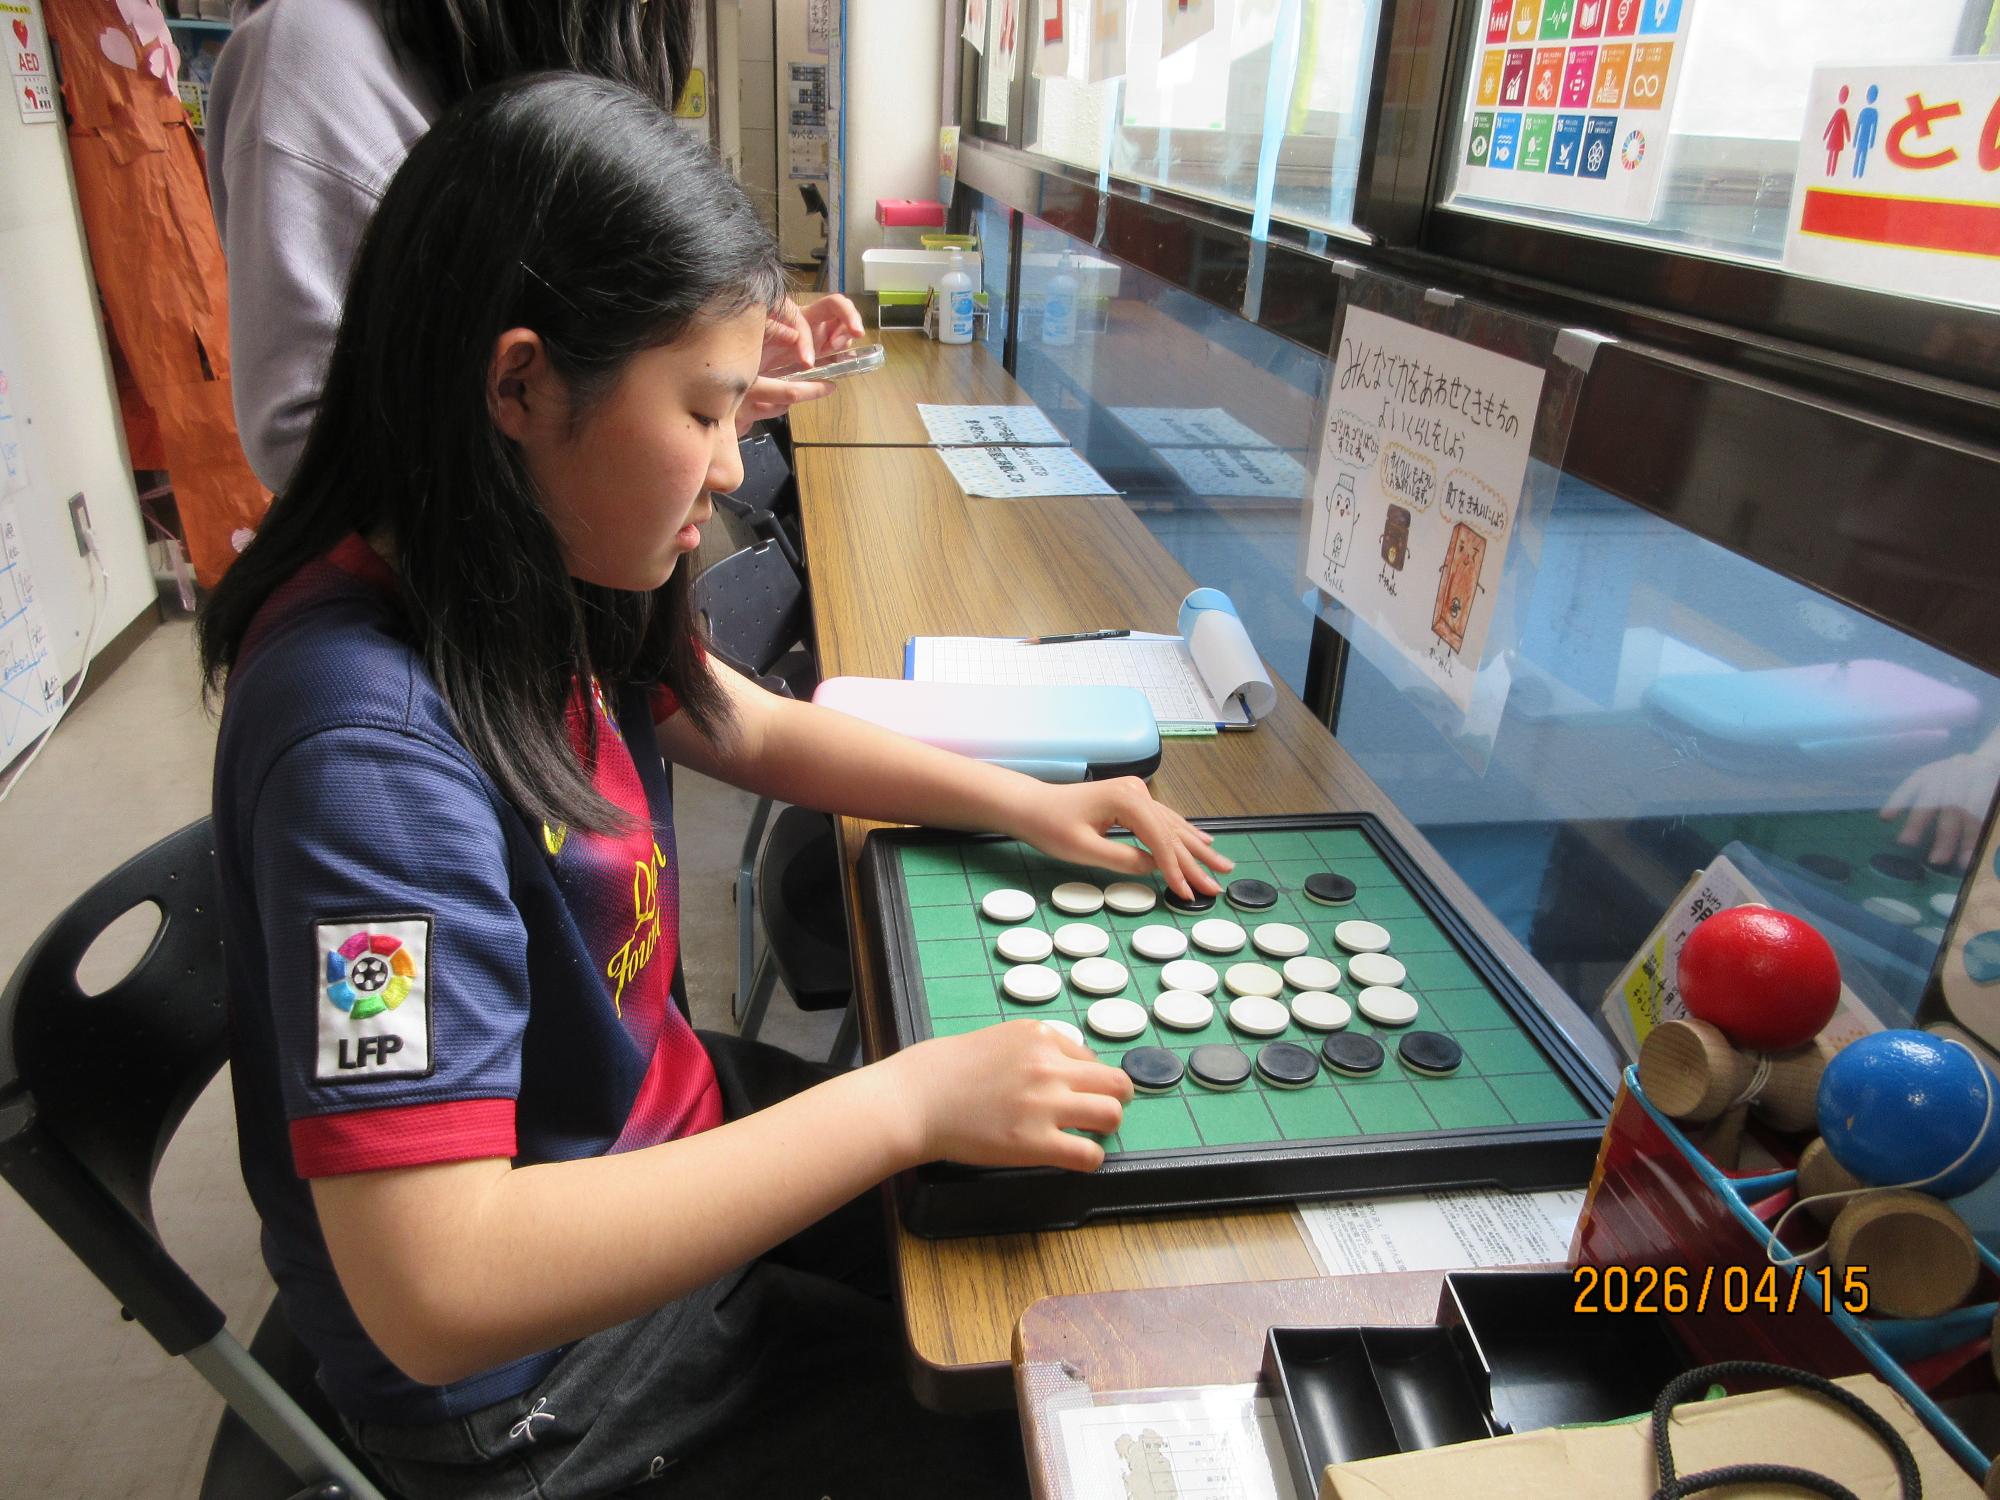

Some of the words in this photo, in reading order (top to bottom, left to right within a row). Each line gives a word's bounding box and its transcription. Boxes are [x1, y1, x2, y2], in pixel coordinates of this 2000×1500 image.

[19, 53, 40, 72] AED
[1635, 48, 1644, 62] 12
[1341, 338, 1519, 439] みんなで力をあわせてきもちの
[1377, 395, 1465, 462] よいくらしをしよう
[338, 1033, 405, 1070] LFP
